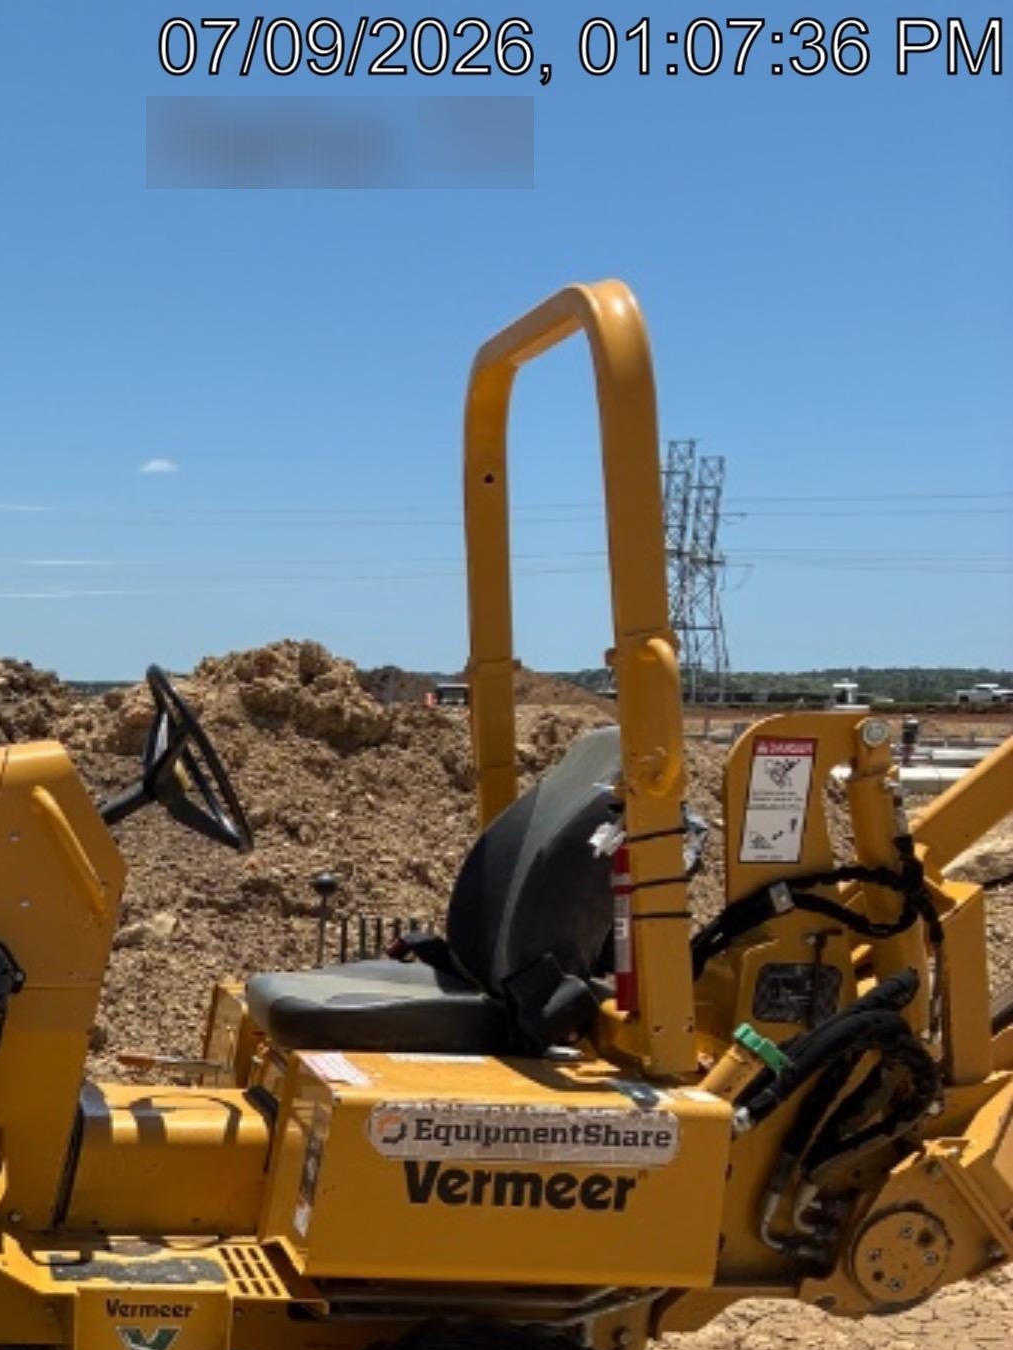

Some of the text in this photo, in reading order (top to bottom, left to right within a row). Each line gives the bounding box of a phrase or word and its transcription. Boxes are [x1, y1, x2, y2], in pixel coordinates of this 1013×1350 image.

[413, 1118, 672, 1148] EquipmentShare
[404, 1160, 636, 1212] Vermeer
[105, 1298, 193, 1318] Vermeer
